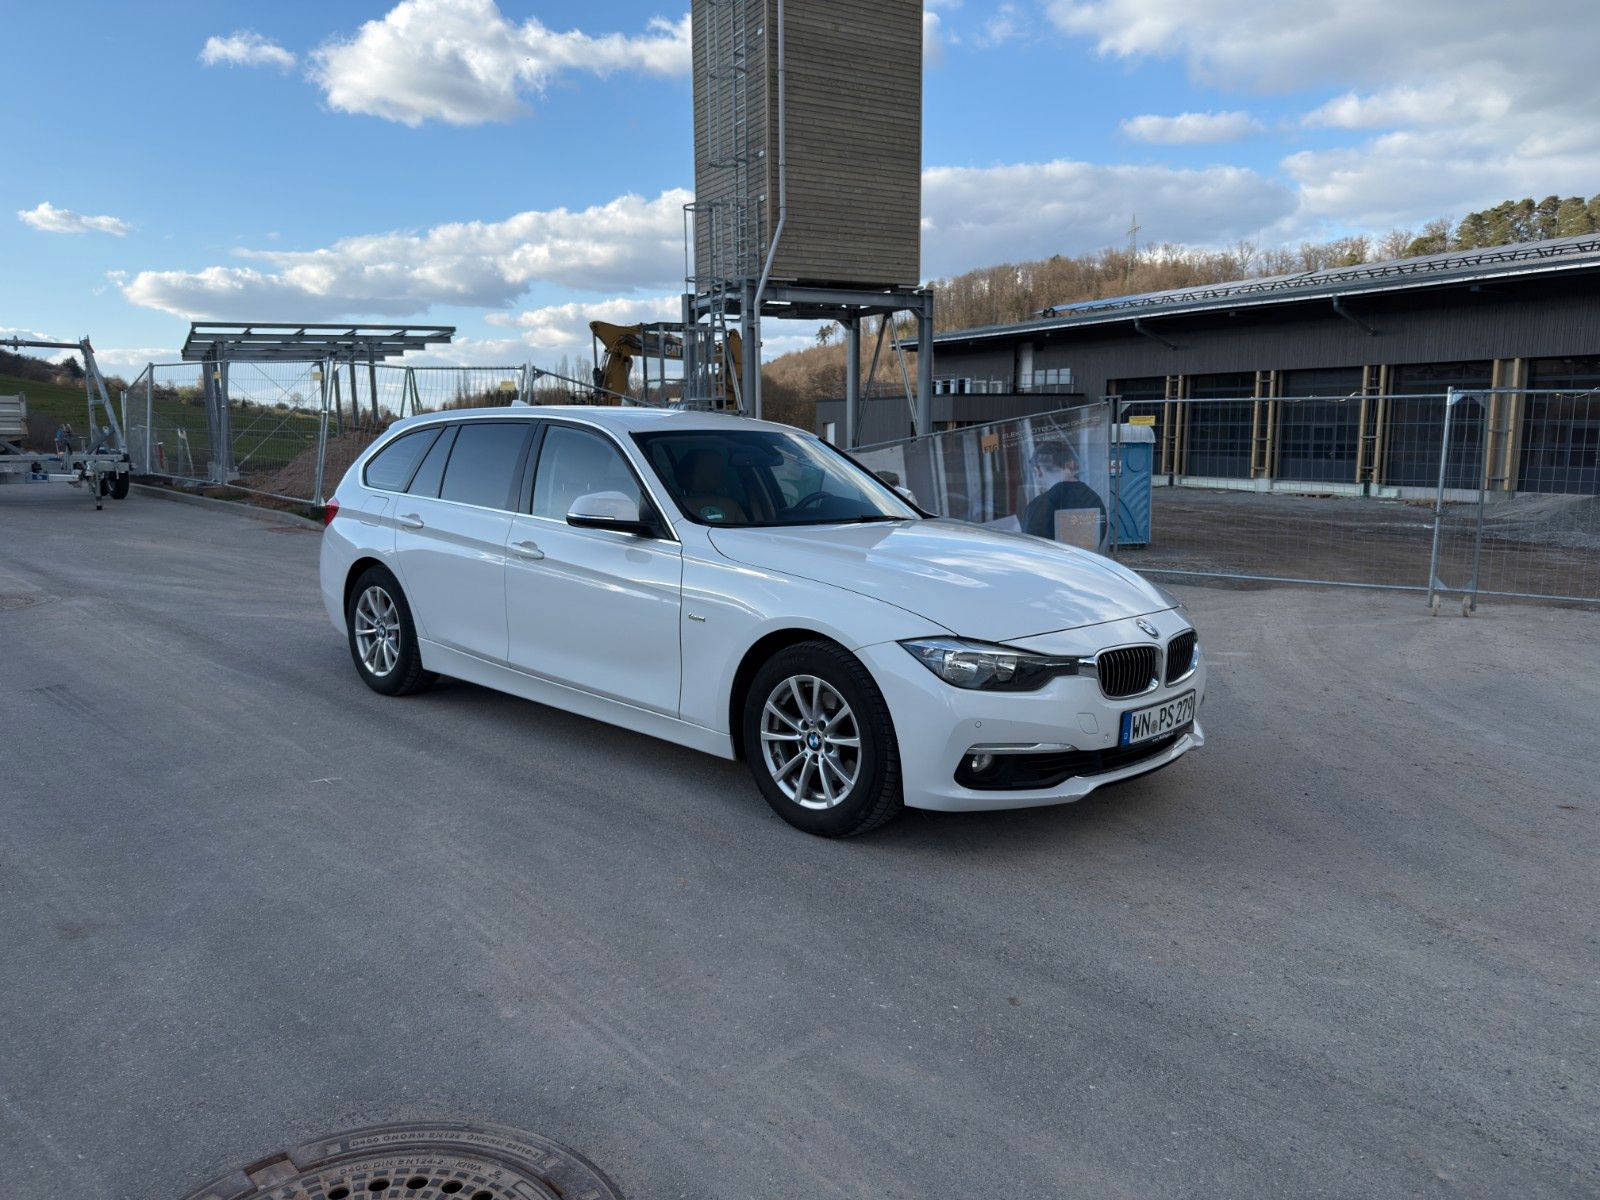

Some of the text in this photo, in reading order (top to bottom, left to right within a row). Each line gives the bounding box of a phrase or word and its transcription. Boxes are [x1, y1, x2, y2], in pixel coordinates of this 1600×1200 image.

[665, 344, 682, 357] CAT
[1132, 711, 1151, 739] WN
[1159, 704, 1174, 731] PS
[1175, 695, 1193, 724] 279
[374, 1160, 393, 1168] DIN
